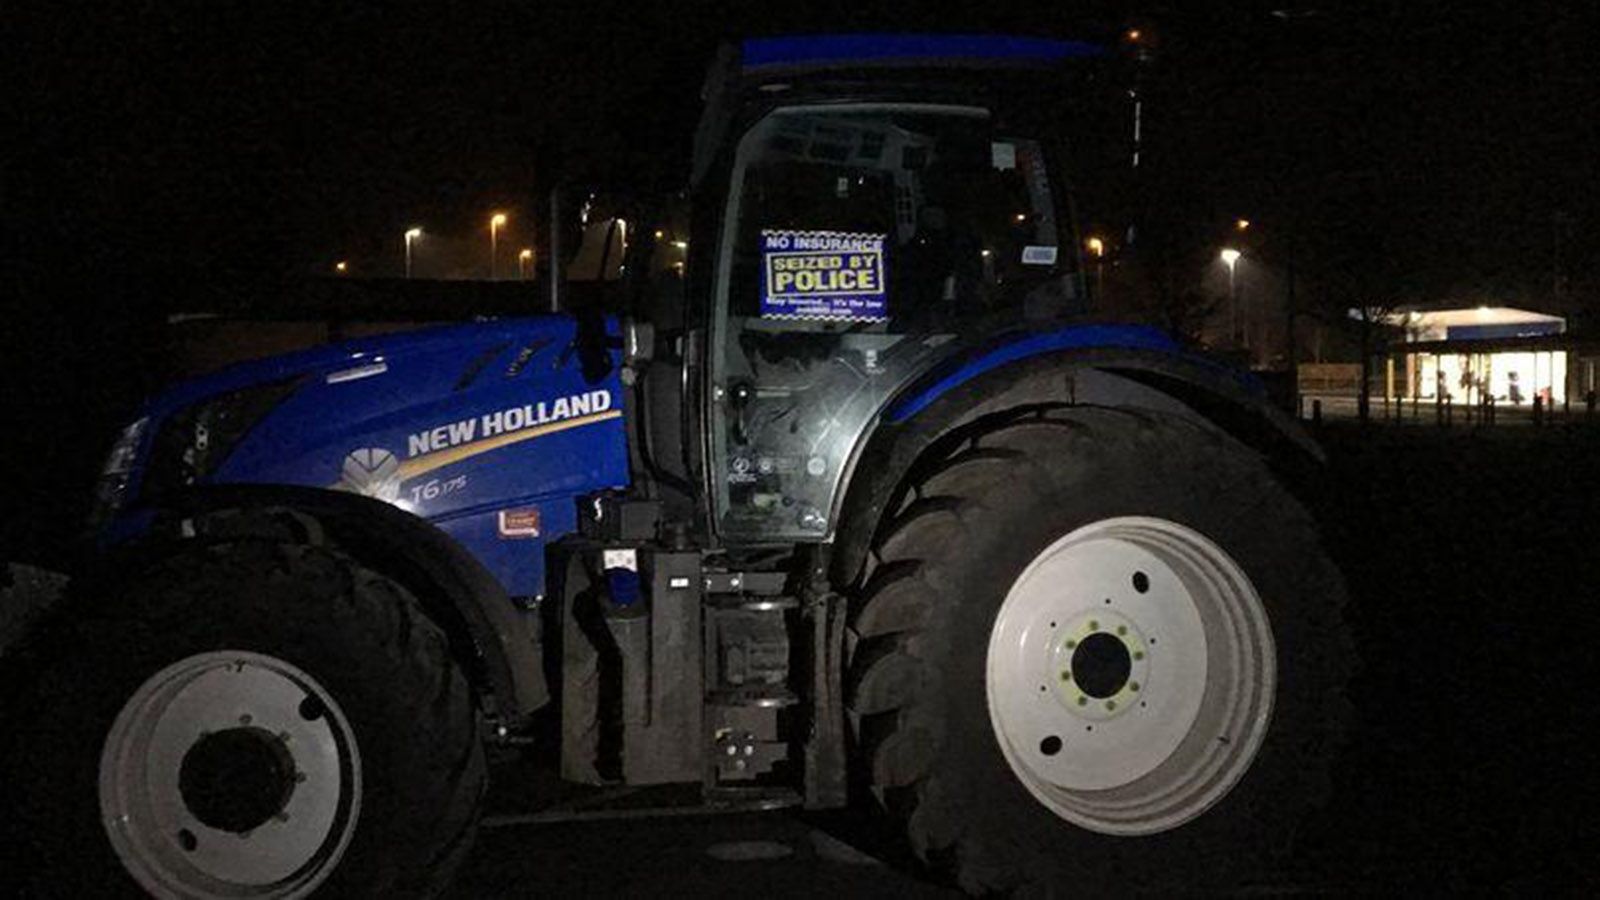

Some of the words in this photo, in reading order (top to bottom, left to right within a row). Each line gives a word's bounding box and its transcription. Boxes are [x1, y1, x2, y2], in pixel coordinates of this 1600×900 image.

[767, 237, 789, 248] NO
[794, 237, 883, 252] INSURANCE
[774, 257, 842, 270] SEIZED
[849, 256, 875, 268] BY
[775, 270, 875, 291] POLICE
[409, 418, 475, 456] NEW
[482, 390, 611, 437] HOLLAND
